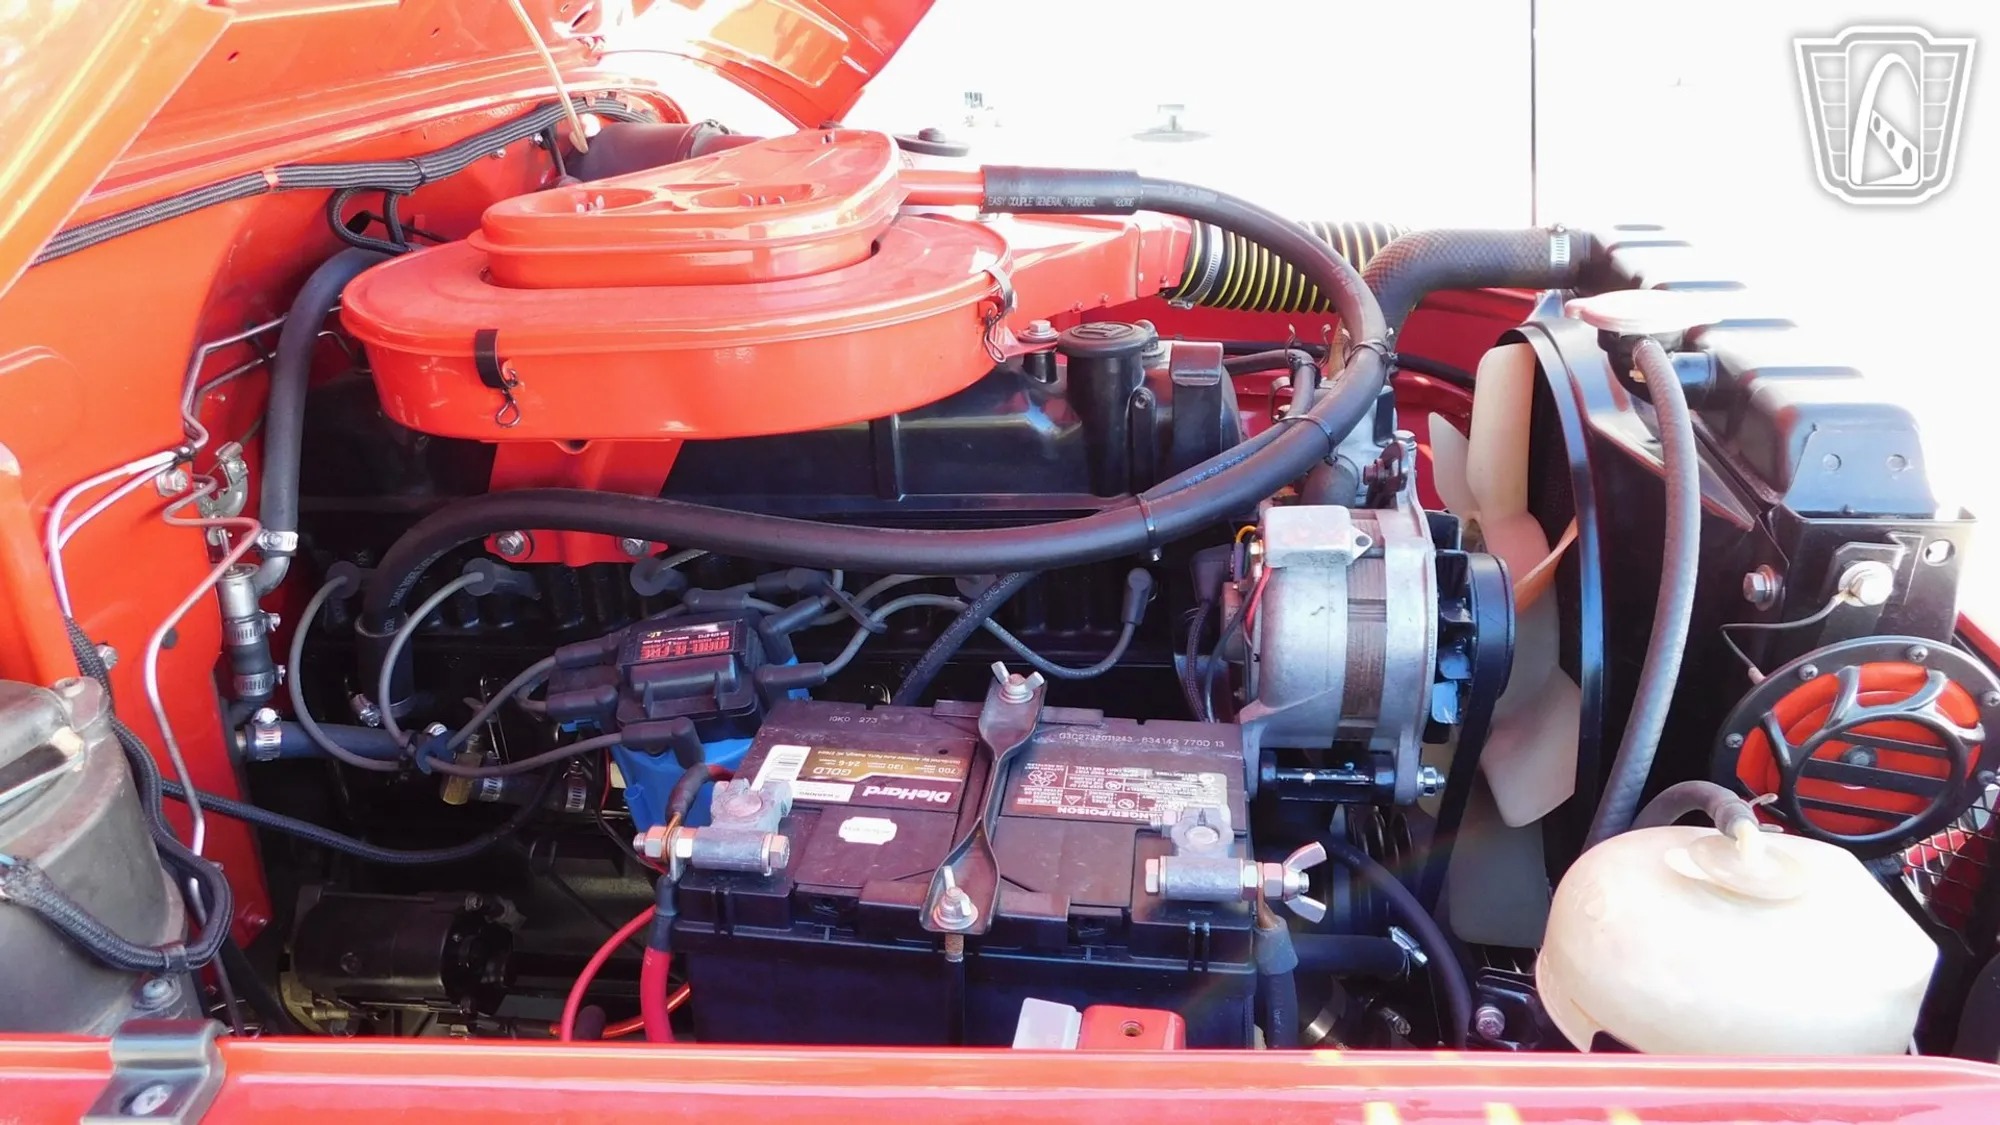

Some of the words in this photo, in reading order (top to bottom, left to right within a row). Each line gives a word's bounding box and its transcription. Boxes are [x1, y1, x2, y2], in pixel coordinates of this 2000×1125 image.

[988, 196, 1006, 207] EASY
[1008, 196, 1034, 207] COUPLE
[1035, 196, 1064, 207] GENERAL
[1067, 196, 1096, 208] PURPOSE
[1215, 740, 1225, 748] 13
[813, 766, 852, 776] GOLD
[938, 767, 957, 775] 700
[863, 787, 951, 803] DieHard
[1057, 807, 1163, 819] ANGER/POISON
